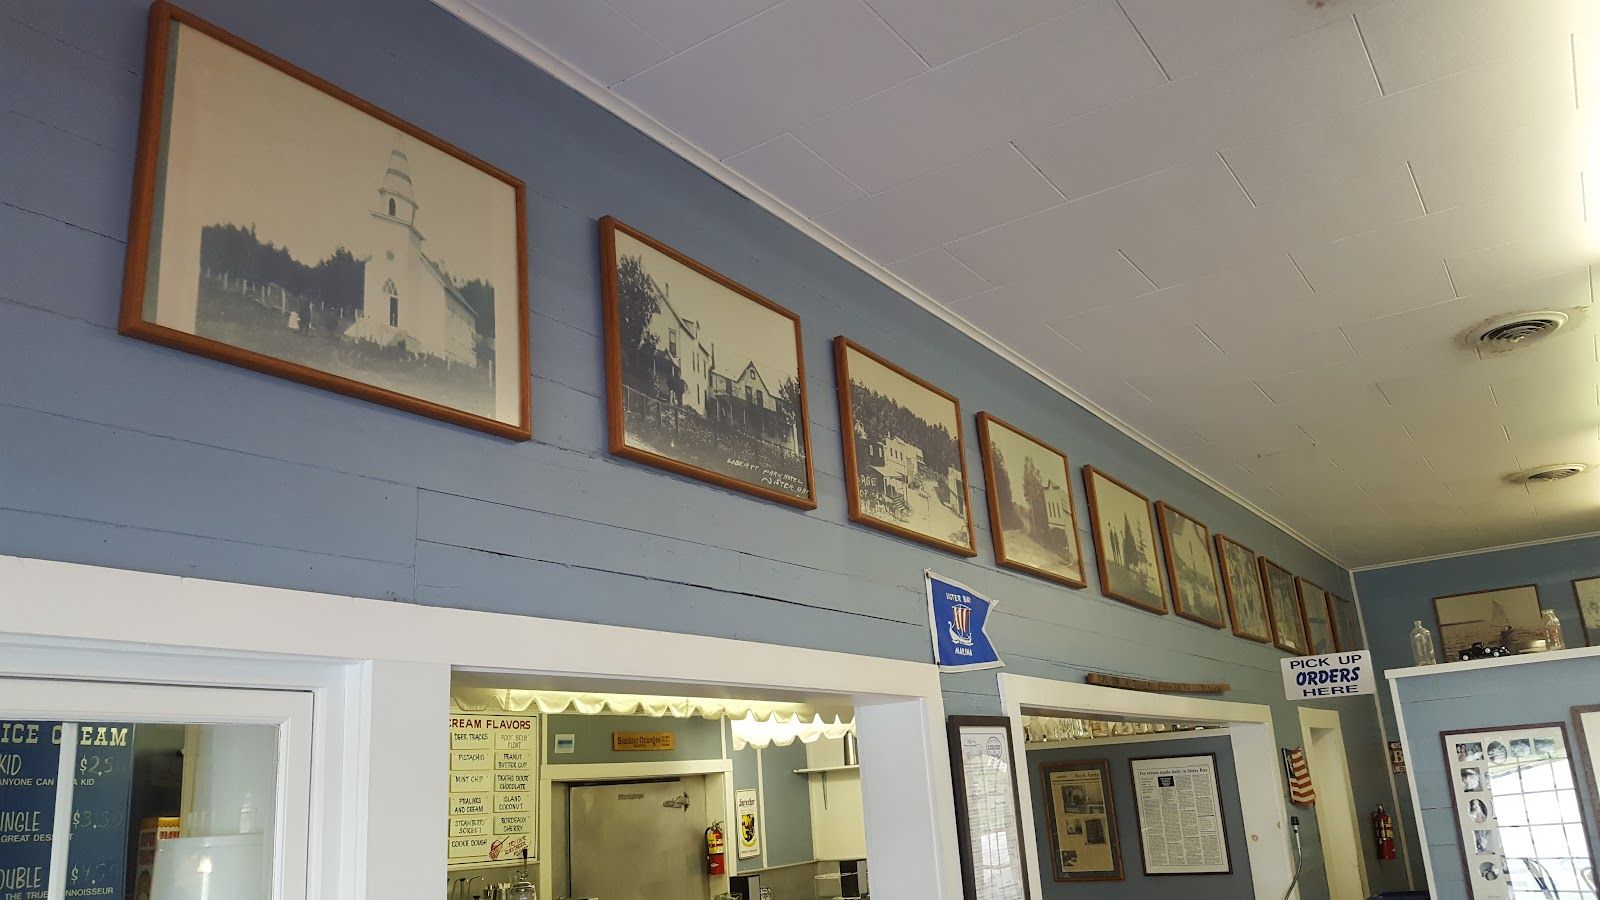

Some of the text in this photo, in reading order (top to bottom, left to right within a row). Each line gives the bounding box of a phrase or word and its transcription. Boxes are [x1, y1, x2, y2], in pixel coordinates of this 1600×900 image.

[955, 647, 972, 656] MARINA
[1290, 654, 1362, 669] PICK UP
[1296, 667, 1360, 686] ORDERS
[1303, 685, 1359, 697] HERE
[486, 719, 531, 730] FLAVORS
[1, 724, 128, 747] ICE CEAM
[454, 733, 488, 741] DEER TRACKS
[458, 753, 485, 761] PISTACHIO
[0, 754, 22, 776] KID
[498, 761, 528, 769] BUTTER CUP
[36, 778, 54, 786] CAN
[80, 778, 95, 786] KID
[455, 775, 484, 783] MINT CHIP
[466, 805, 484, 813] CREAM
[0, 811, 41, 832] INGLE
[503, 825, 524, 833] CHERRY
[1, 834, 30, 842] GREAT
[451, 838, 488, 848] COOKIE DOUGH
[0, 866, 42, 890] OUBLE
[65, 887, 114, 897] NNOISSEUR
